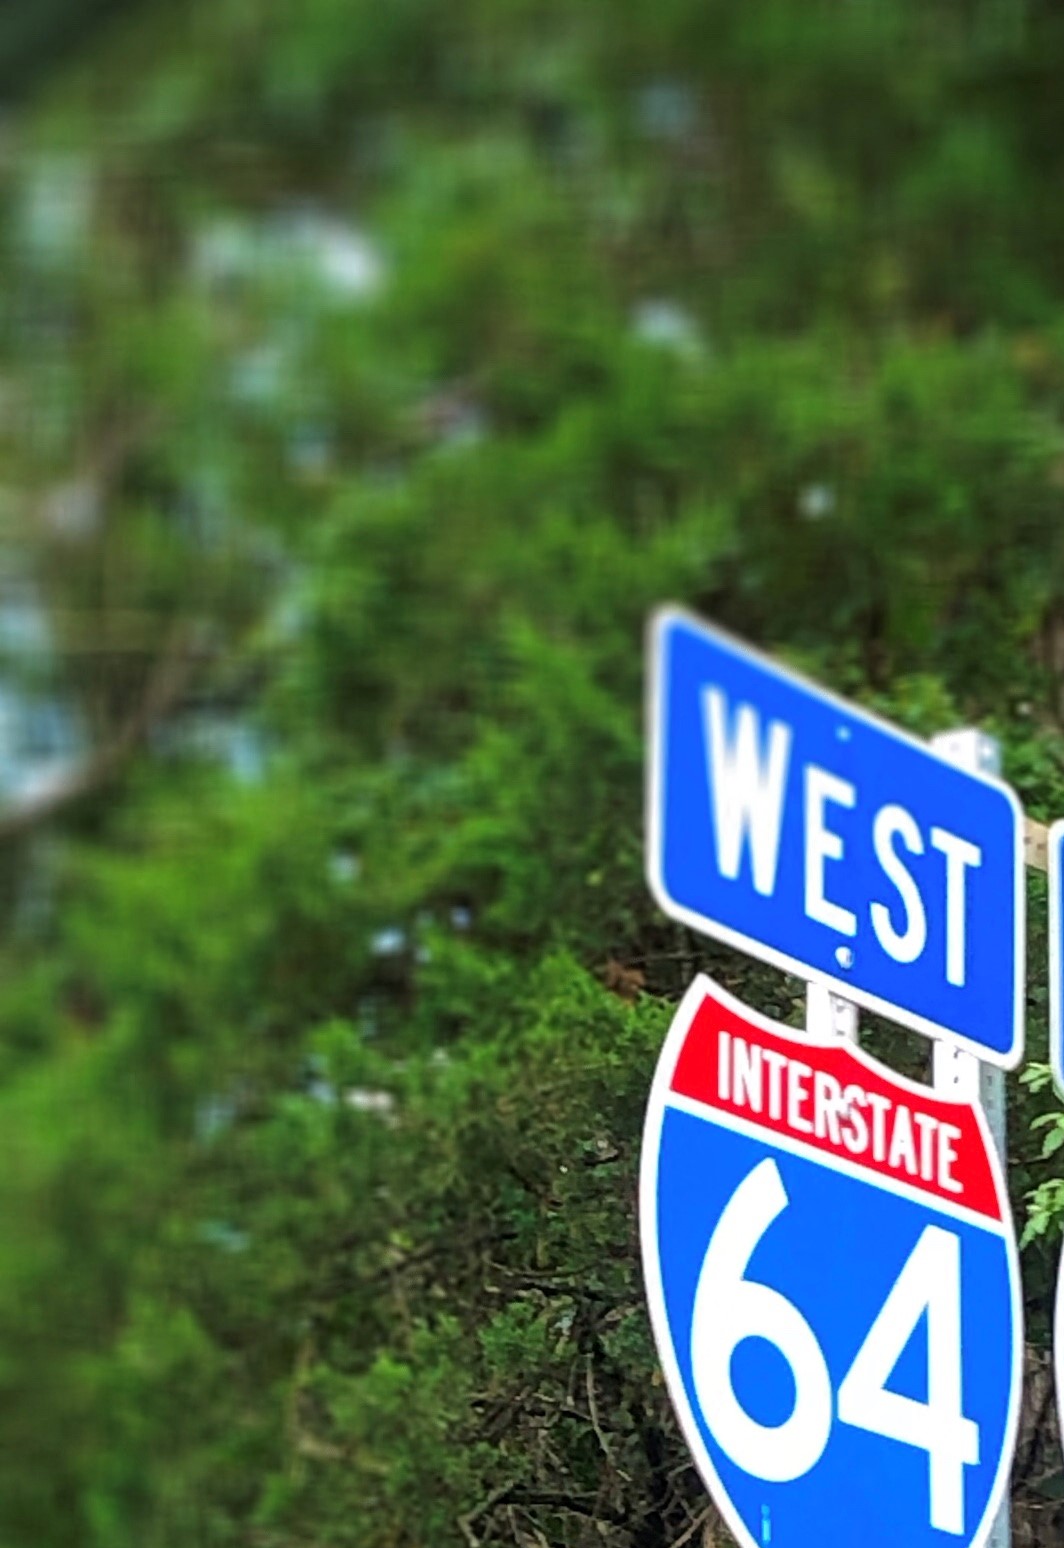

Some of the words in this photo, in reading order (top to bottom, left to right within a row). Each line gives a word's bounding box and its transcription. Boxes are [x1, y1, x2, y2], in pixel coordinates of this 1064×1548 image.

[704, 688, 982, 986] WEST
[718, 1031, 964, 1193] INTERSTATE
[691, 1159, 979, 1535] 64
